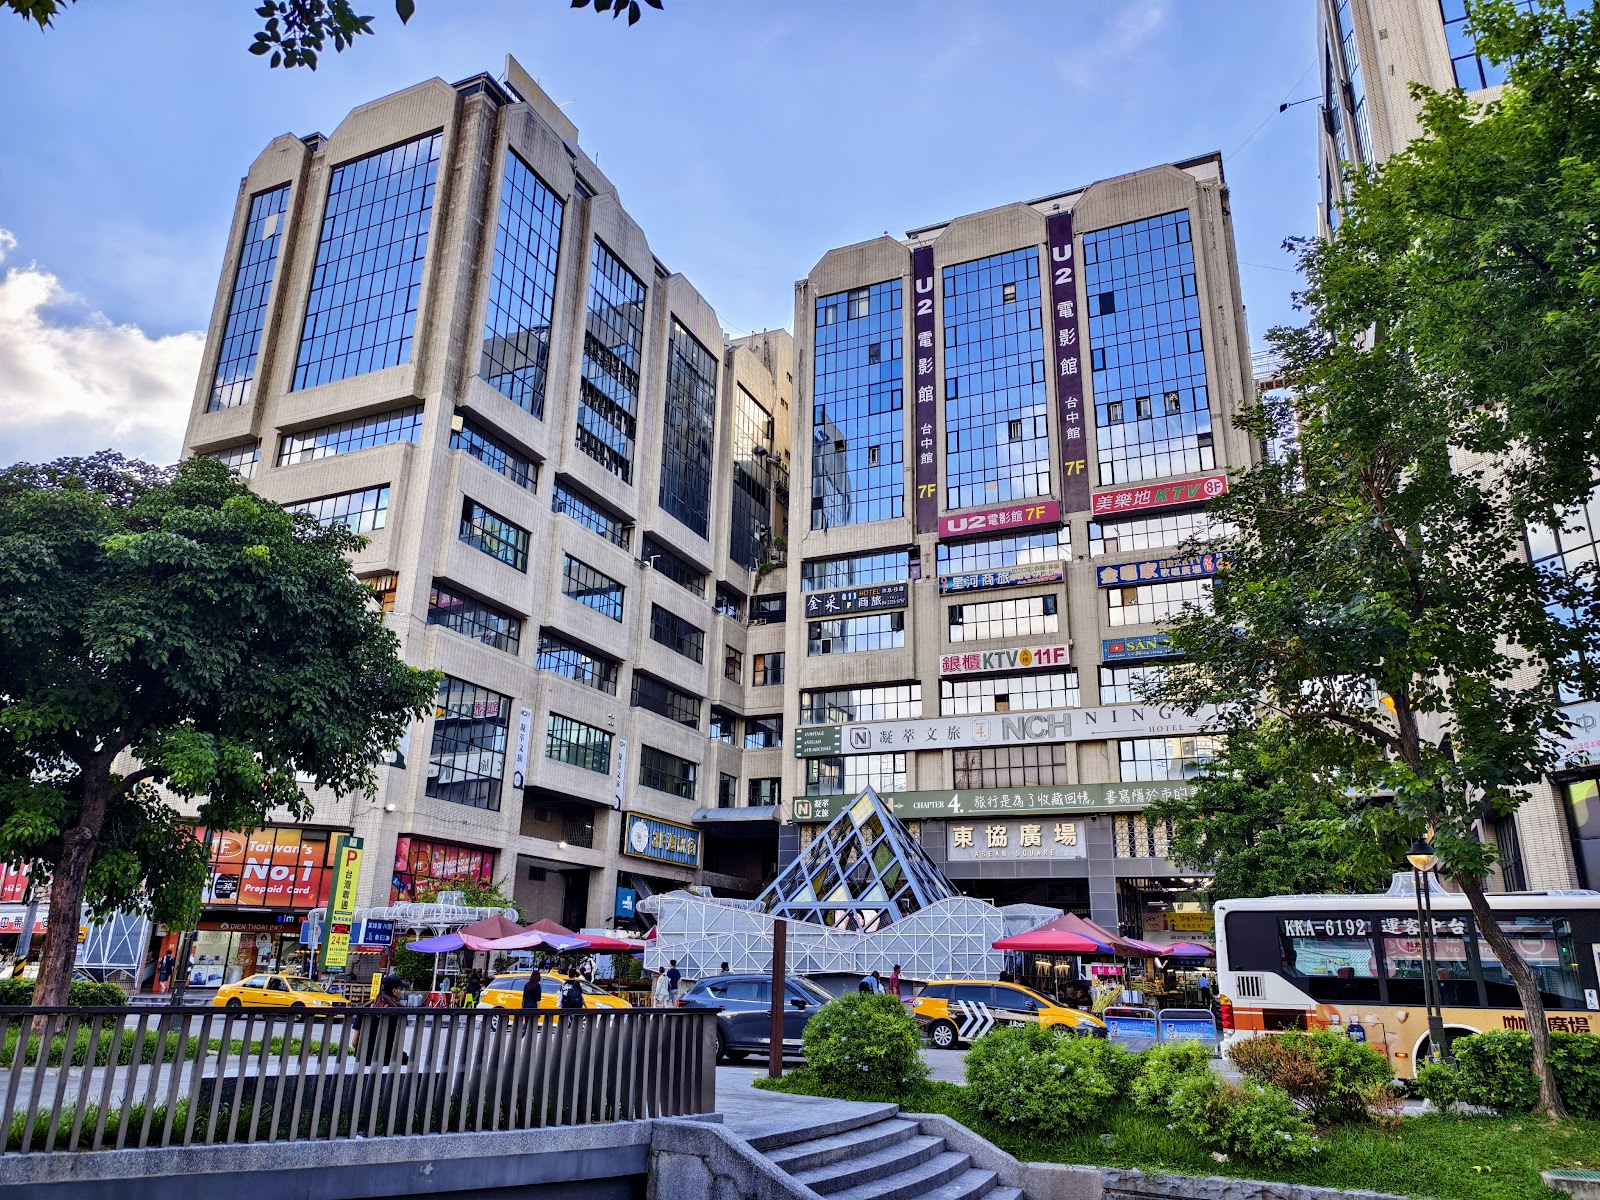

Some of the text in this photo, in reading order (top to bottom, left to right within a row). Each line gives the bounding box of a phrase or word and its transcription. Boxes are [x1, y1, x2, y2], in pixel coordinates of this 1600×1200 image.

[1064, 460, 1085, 476] 7F
[918, 484, 936, 499] 7F
[1205, 481, 1221, 494] 8F
[1025, 506, 1046, 521] 7F
[952, 572, 1011, 590] 星河商旅
[859, 589, 880, 597] HOTEL
[858, 595, 882, 608] 商旅
[1034, 647, 1065, 665] 11F
[1001, 712, 1072, 741] NCH
[1149, 724, 1185, 733] HOTEL
[879, 725, 961, 744] 凝萃文旅
[913, 801, 945, 809] CHAPTER
[952, 822, 1077, 849] 東協廣場
[250, 841, 313, 855] Taiwan's
[974, 849, 1055, 858] ASEAN SQUARE
[345, 849, 358, 867] P
[243, 857, 314, 882] No.1
[244, 884, 283, 894] Prepaid
[286, 885, 310, 894] Card
[1284, 919, 1366, 937] KKA-6192
[331, 935, 341, 945] 24
